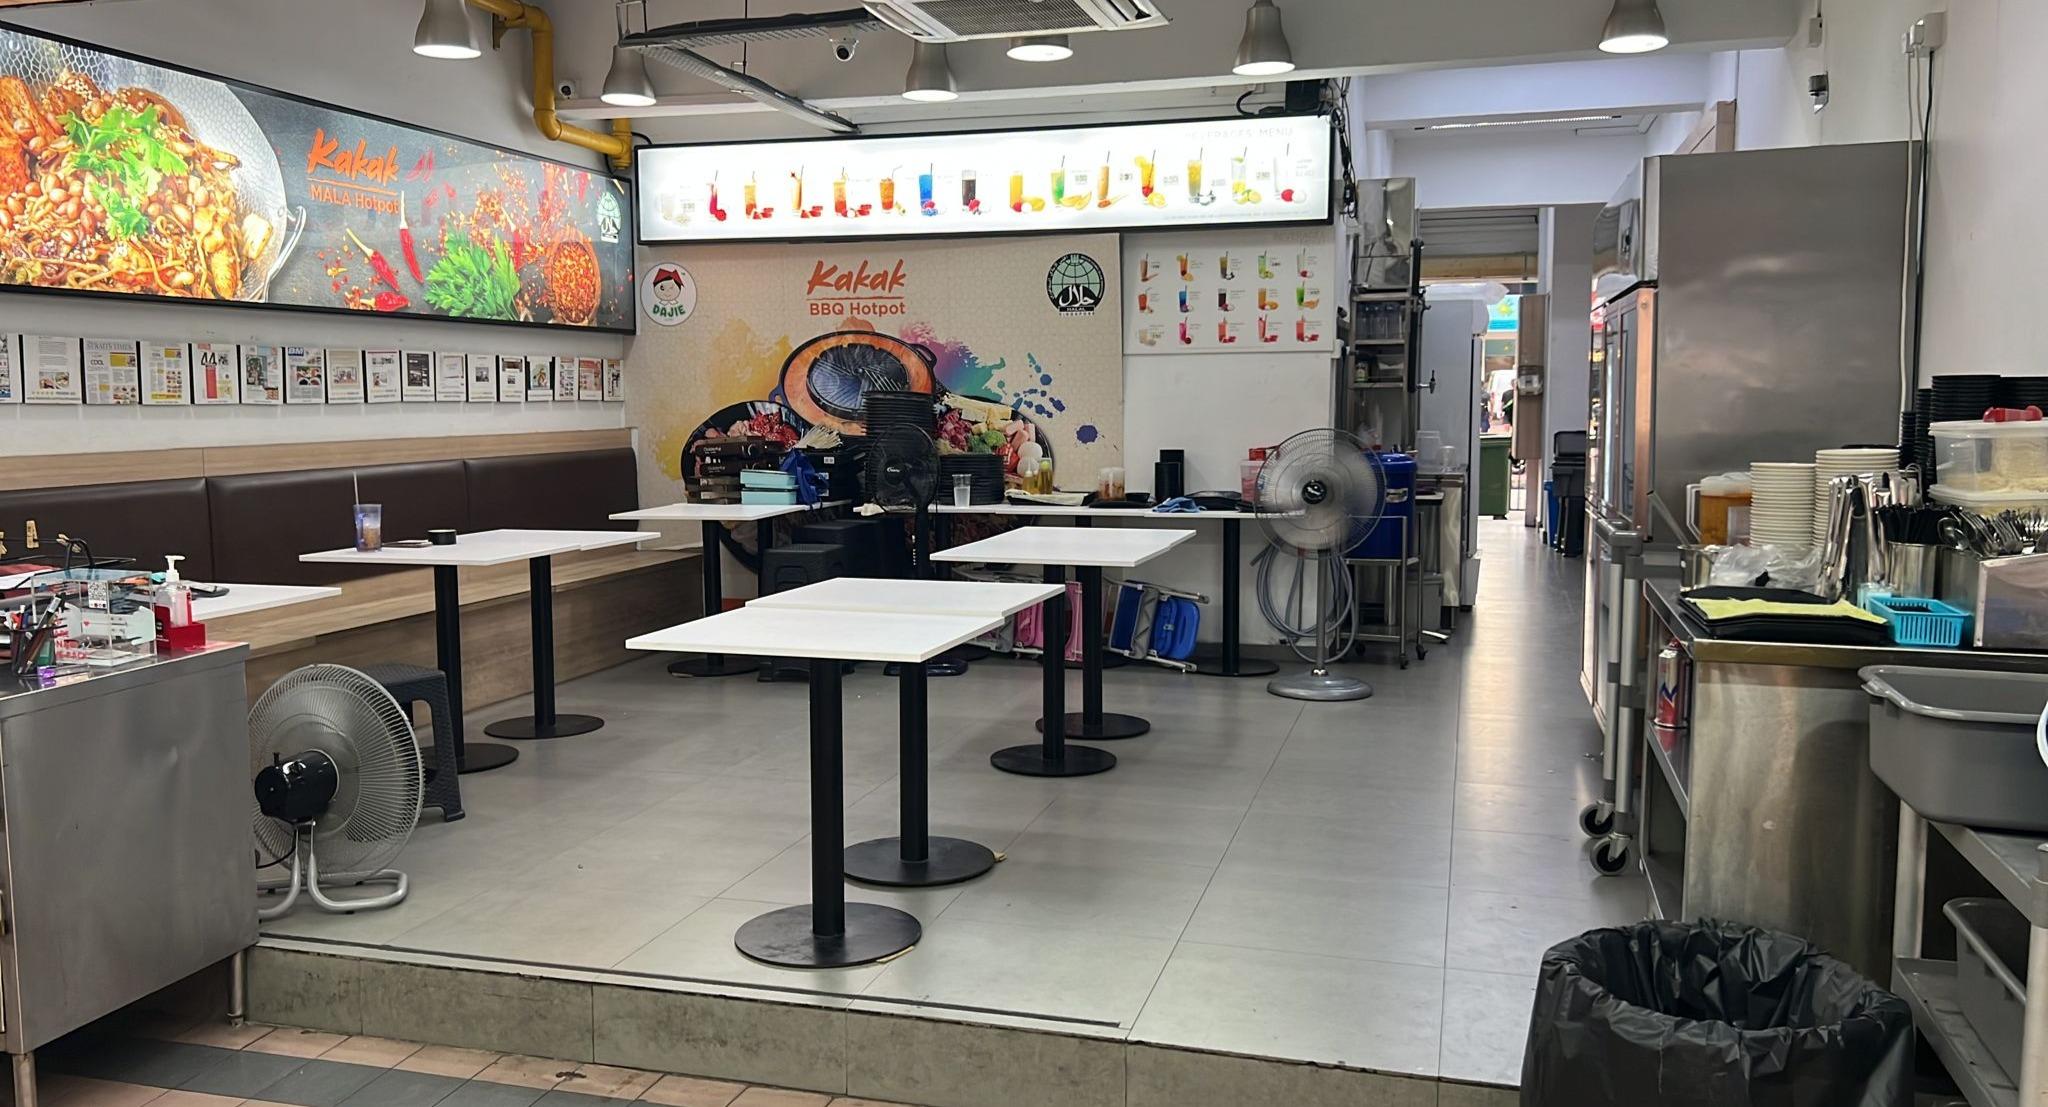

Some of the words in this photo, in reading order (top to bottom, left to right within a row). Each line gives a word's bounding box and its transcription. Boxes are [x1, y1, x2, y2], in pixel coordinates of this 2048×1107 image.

[307, 128, 399, 186] Kakak
[310, 184, 352, 206] MALA
[355, 192, 399, 215] Hotpot
[807, 258, 906, 295] Kakak
[652, 304, 686, 317] DAJIE
[810, 302, 844, 315] BBQ
[850, 301, 906, 317] Hotpot
